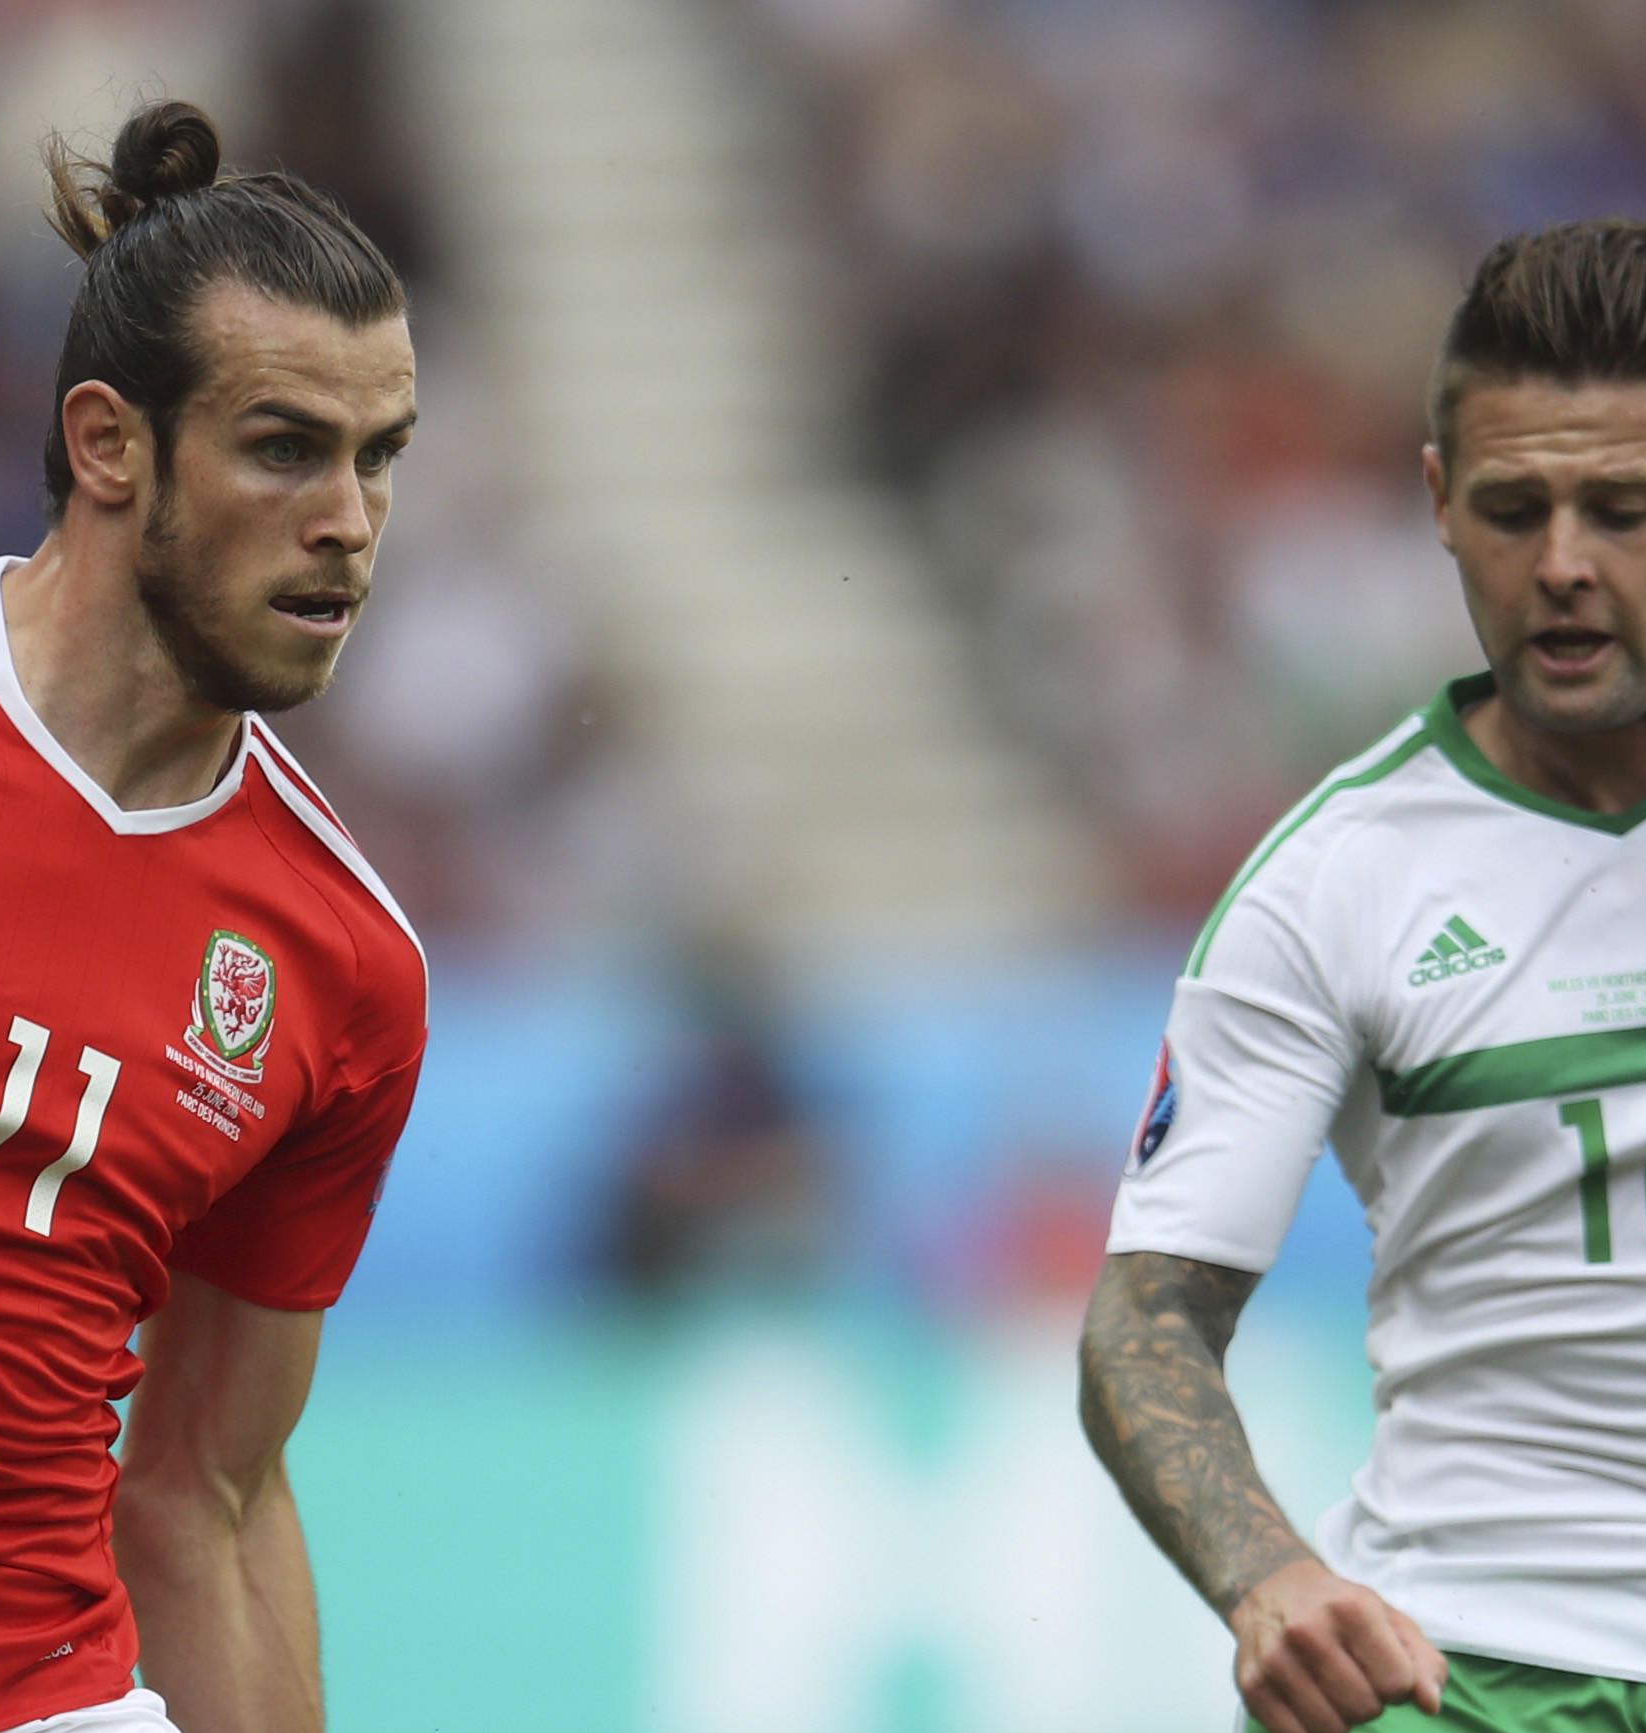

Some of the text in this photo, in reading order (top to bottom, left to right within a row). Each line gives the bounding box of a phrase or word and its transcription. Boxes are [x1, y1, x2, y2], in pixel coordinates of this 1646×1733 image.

[1408, 947, 1506, 987] adidas
[165, 1044, 194, 1072] WALES
[194, 1062, 205, 1079] VS
[205, 1069, 242, 1102] NORTHERN
[239, 1092, 266, 1120] IRELAND
[192, 1081, 207, 1097] 25
[202, 1089, 227, 1110] JUNE
[175, 1090, 241, 1142] PARC DES PRINCES
